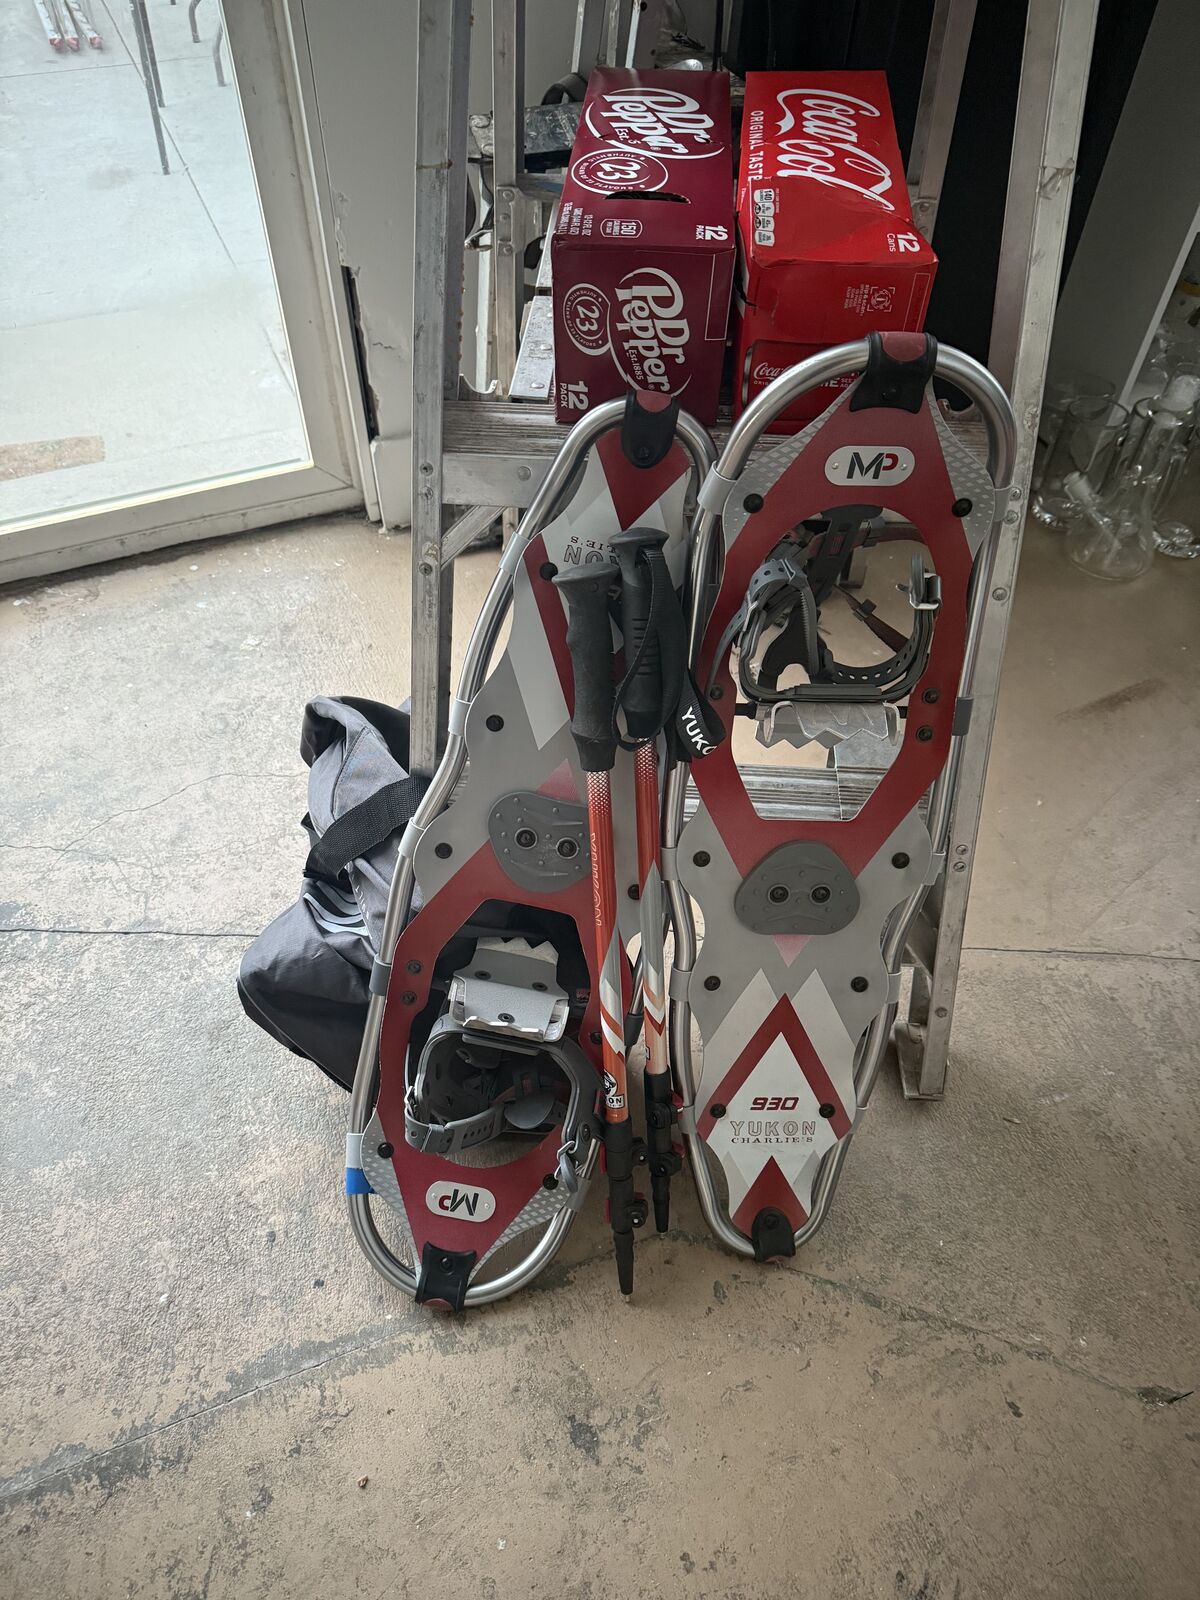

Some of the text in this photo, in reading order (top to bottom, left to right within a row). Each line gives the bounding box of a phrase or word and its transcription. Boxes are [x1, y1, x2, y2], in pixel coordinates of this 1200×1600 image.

[600, 87, 700, 154] Pepper
[655, 112, 715, 143] Dr
[748, 110, 764, 182] ORIGINAL TASTE
[596, 162, 641, 180] 23
[621, 222, 636, 236] 150
[695, 224, 704, 240] PACK
[705, 225, 729, 241] 12
[897, 232, 921, 252] 12
[886, 233, 896, 252] Cans
[576, 305, 600, 332] 23
[615, 267, 683, 391] Pepper
[653, 318, 690, 364] Dr
[559, 382, 568, 408] PACK
[567, 380, 589, 410] 12
[846, 451, 899, 480] MP
[570, 535, 616, 553] LIE'S
[681, 706, 718, 755] YUKO
[750, 1097, 799, 1111] 930
[730, 1120, 816, 1137] YUKON
